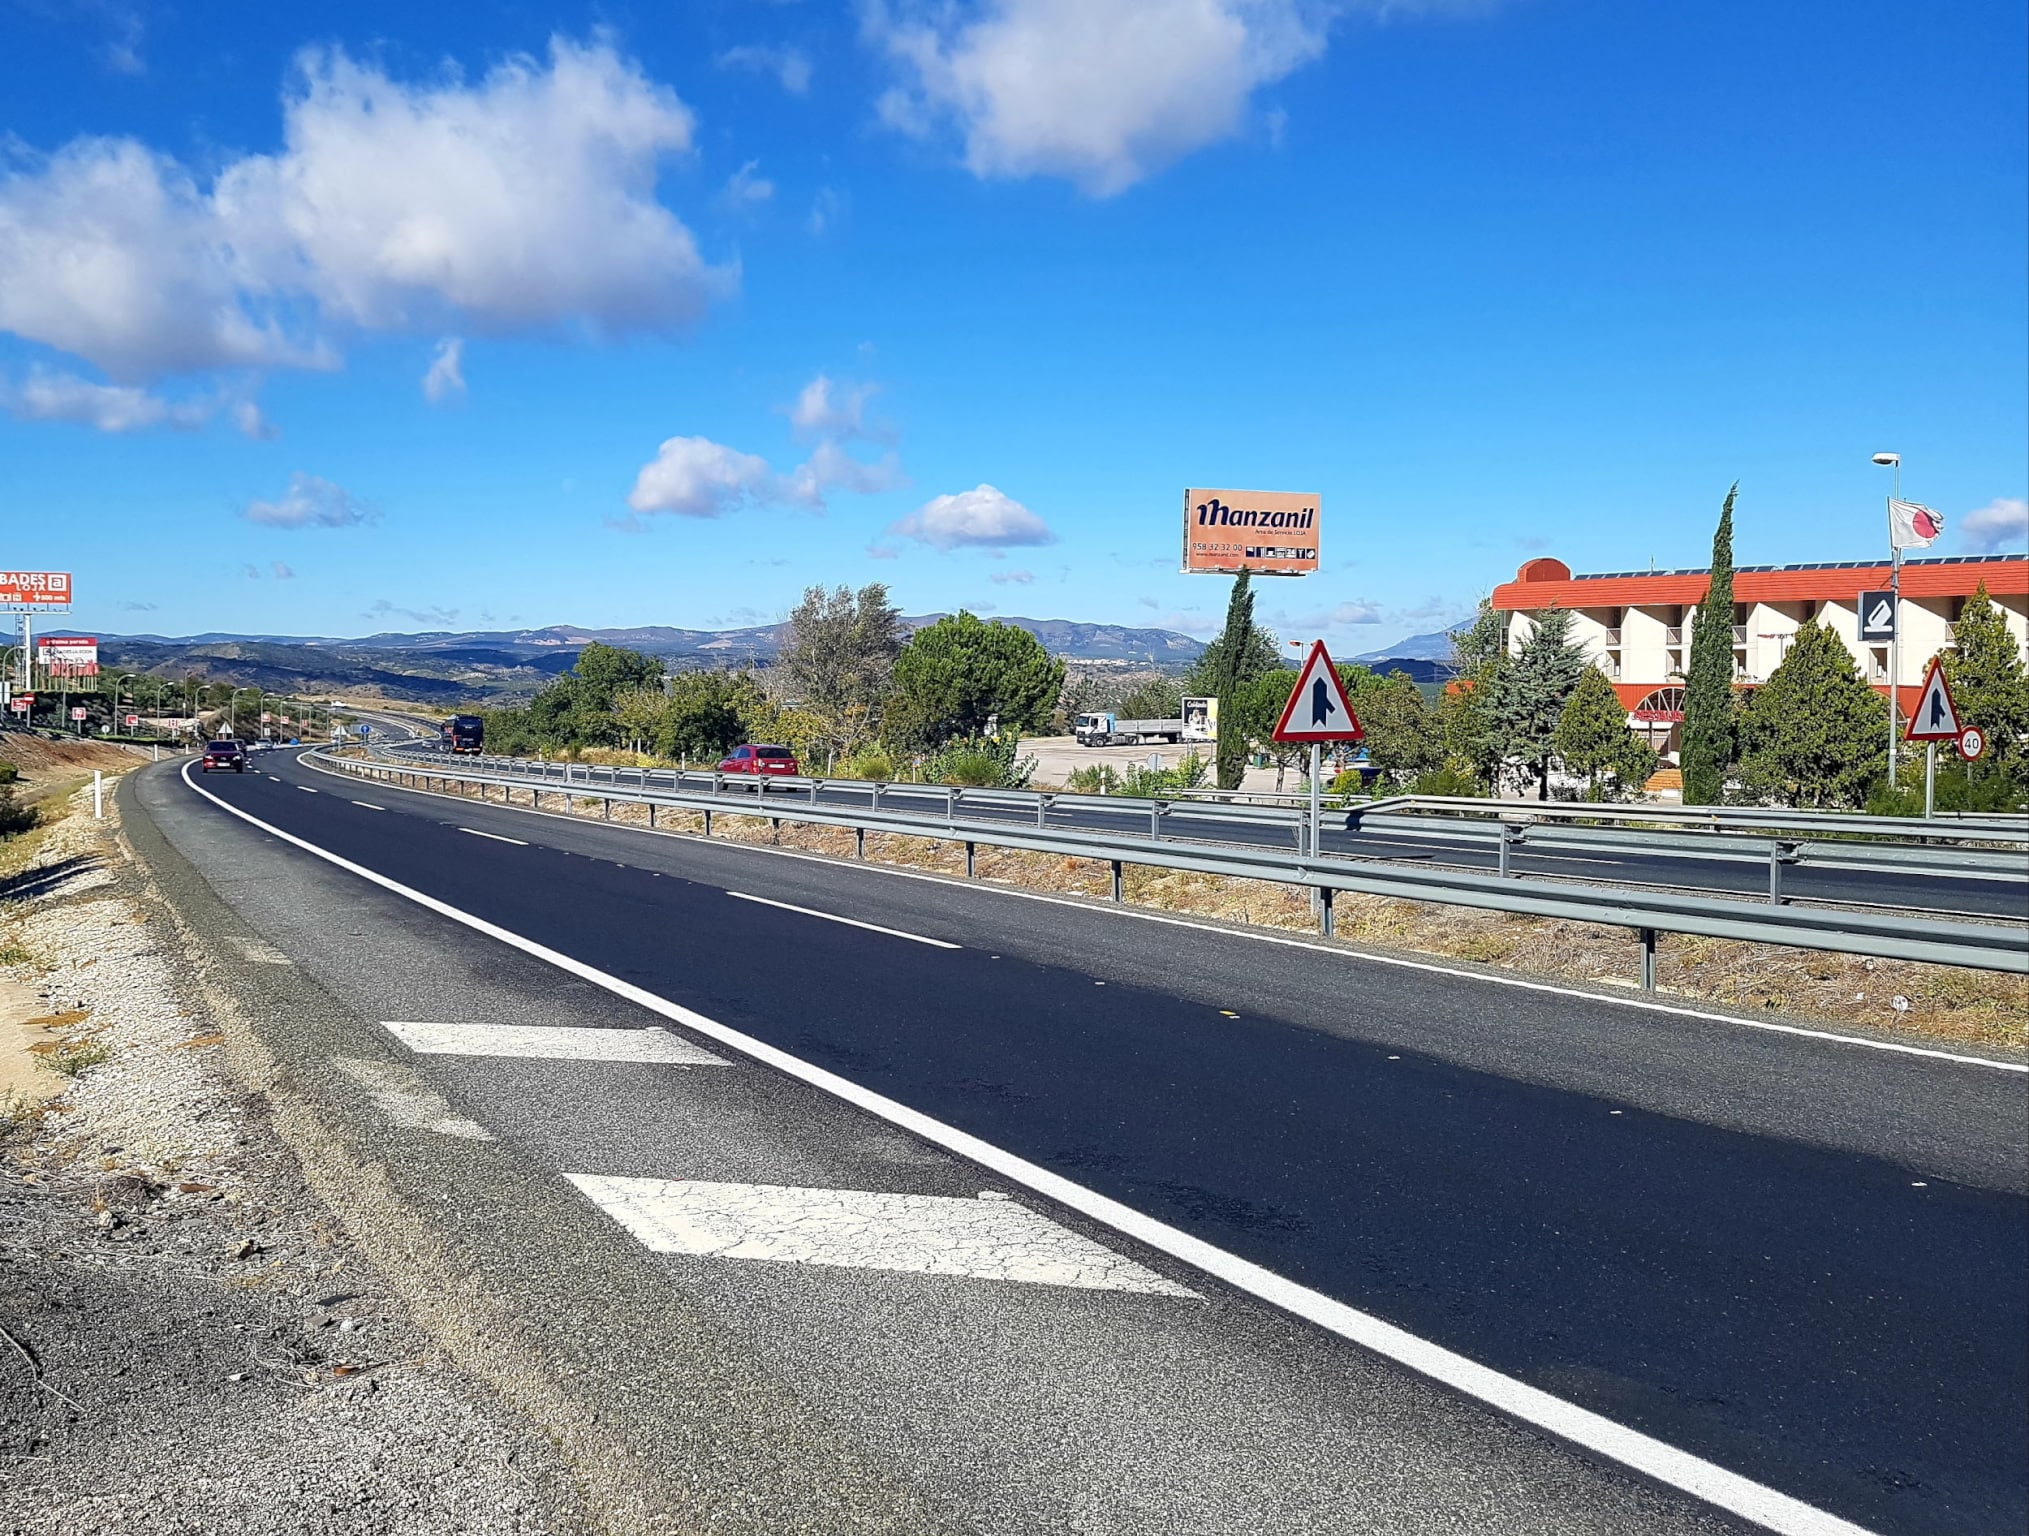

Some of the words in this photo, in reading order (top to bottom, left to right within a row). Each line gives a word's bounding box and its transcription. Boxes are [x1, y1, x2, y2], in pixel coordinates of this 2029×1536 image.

[1197, 498, 1314, 528] Manzanil
[1192, 543, 1207, 551] 958
[16, 584, 46, 592] LOJA
[1964, 738, 1980, 749] 40
